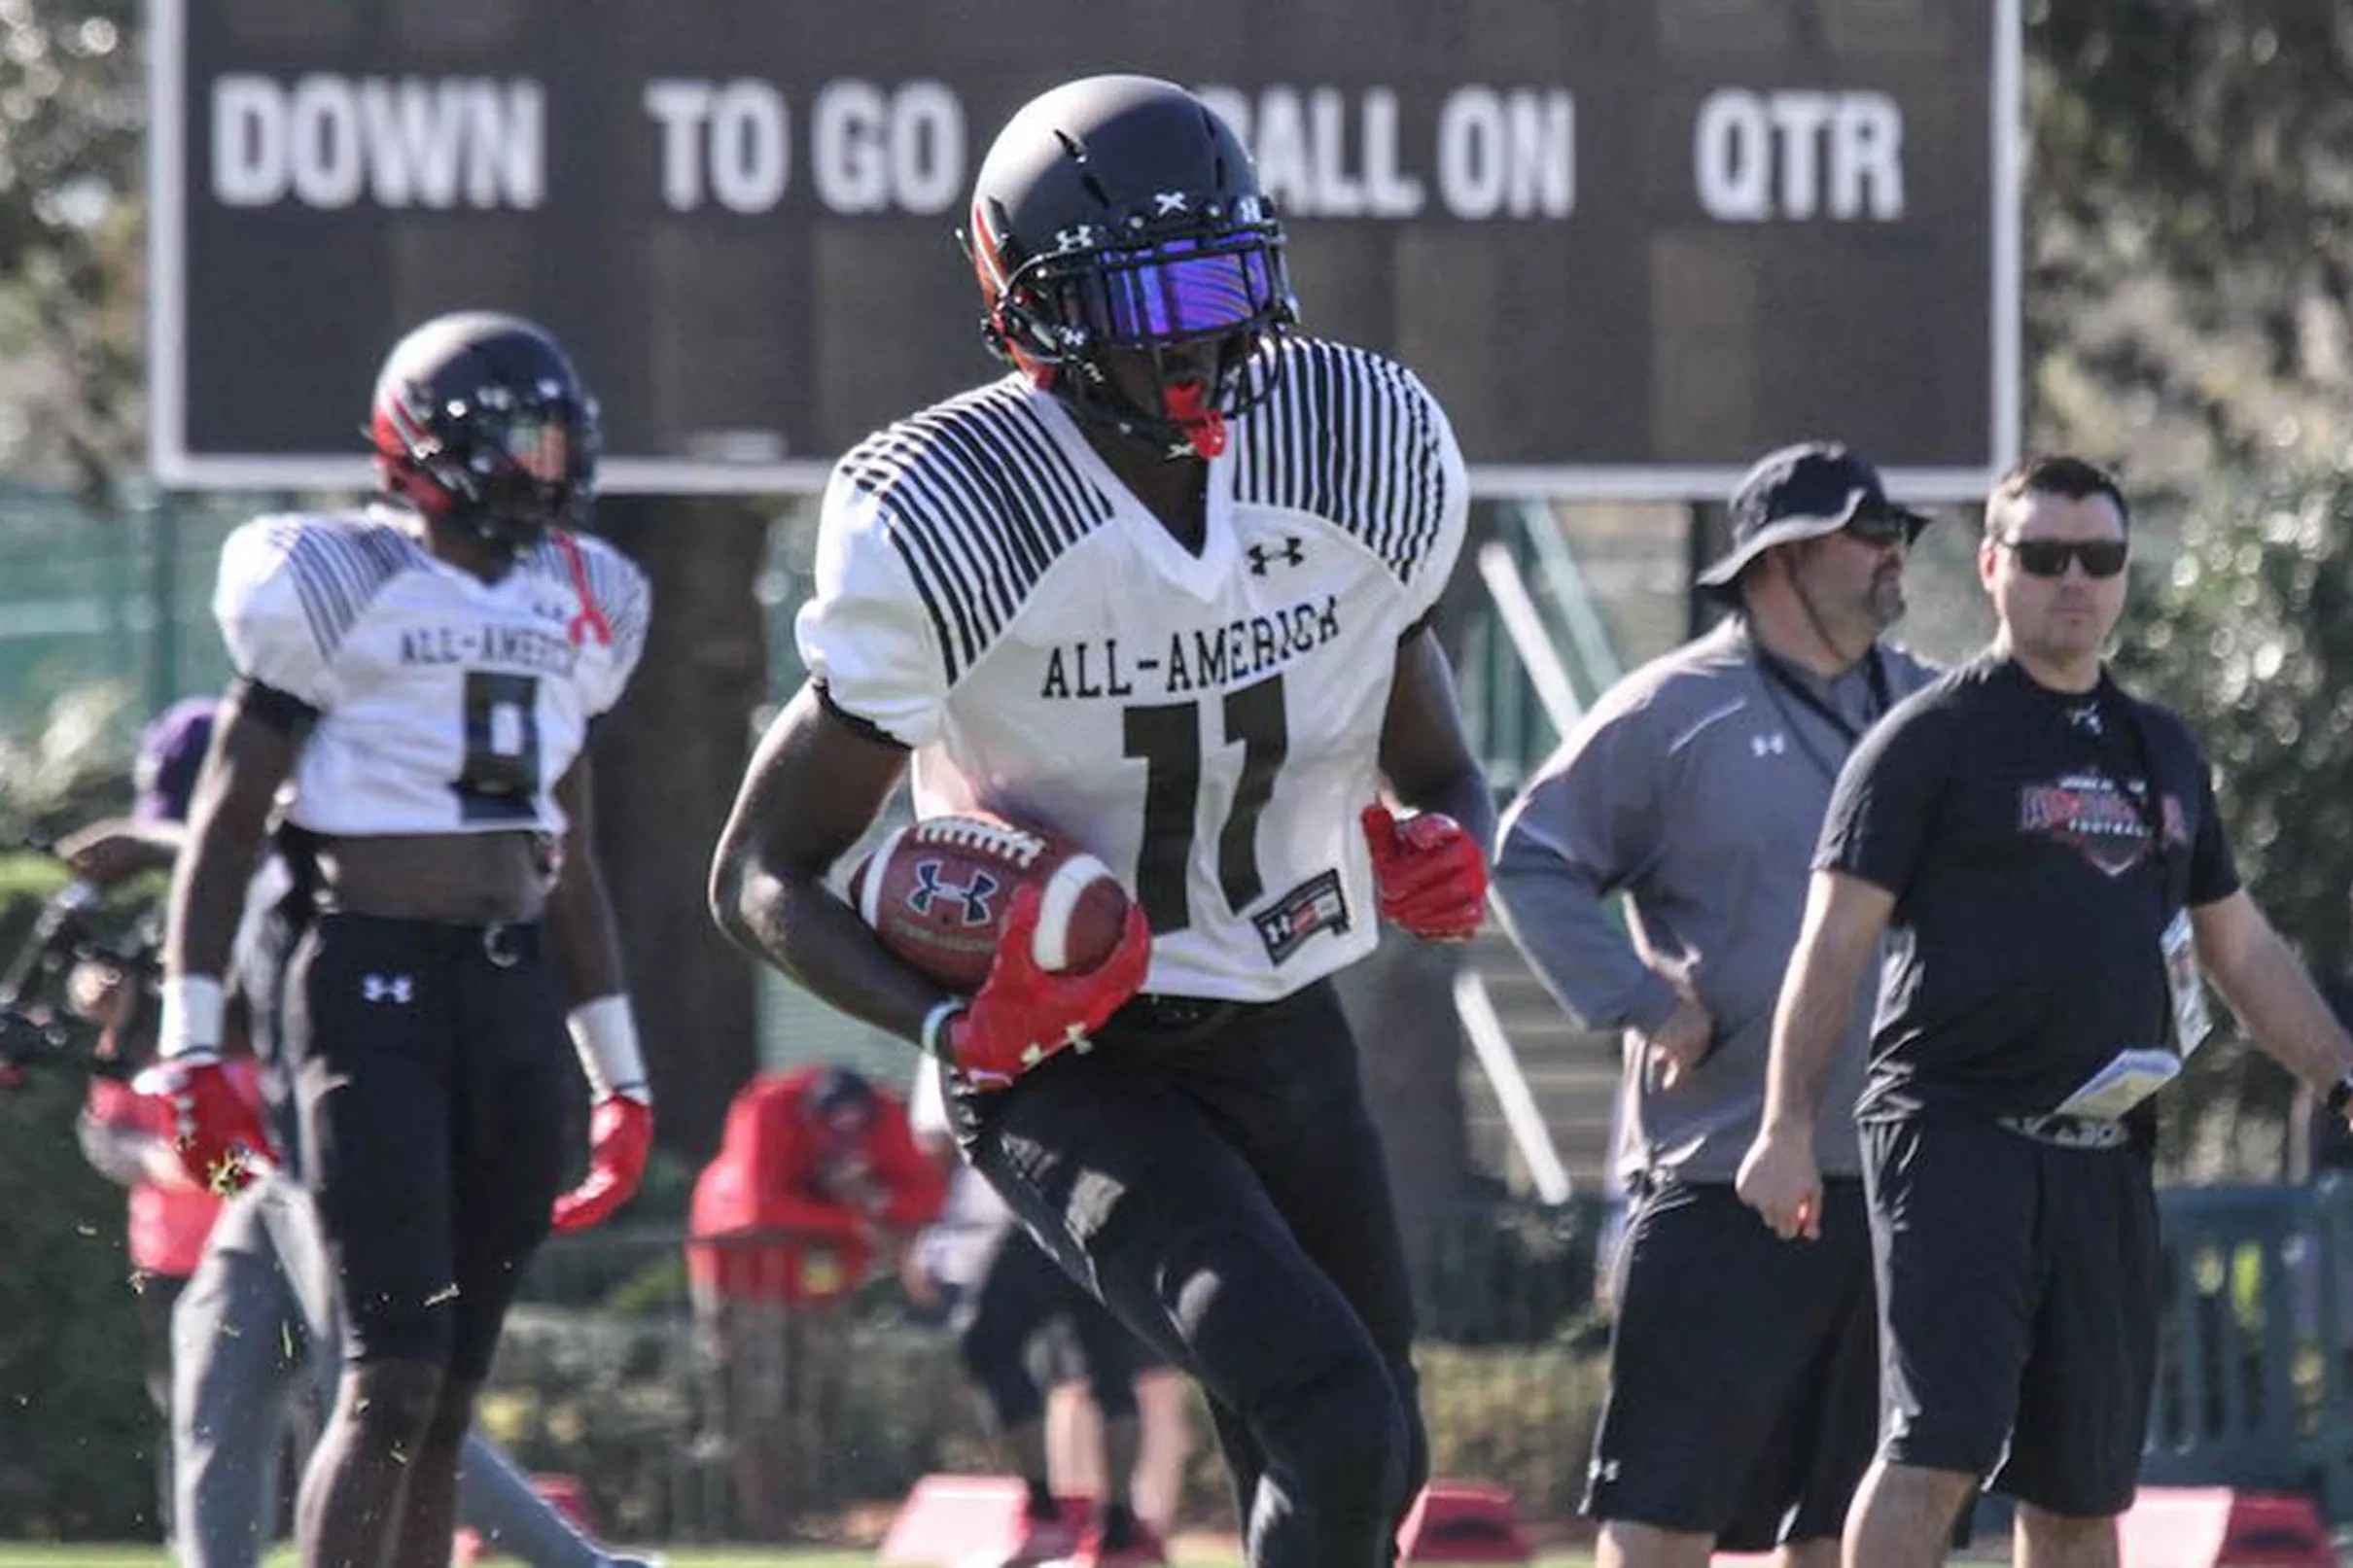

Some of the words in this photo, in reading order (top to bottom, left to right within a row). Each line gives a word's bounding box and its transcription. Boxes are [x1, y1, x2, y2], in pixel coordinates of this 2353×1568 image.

[211, 73, 544, 208] DOWN
[644, 79, 790, 213] TO
[813, 79, 966, 214] GO
[1195, 85, 1422, 218] ALL
[1439, 86, 1576, 219] ON
[1696, 88, 1904, 222] QTR
[1041, 596, 1341, 698] ALL-AMERICA
[1122, 673, 1288, 937] 11
